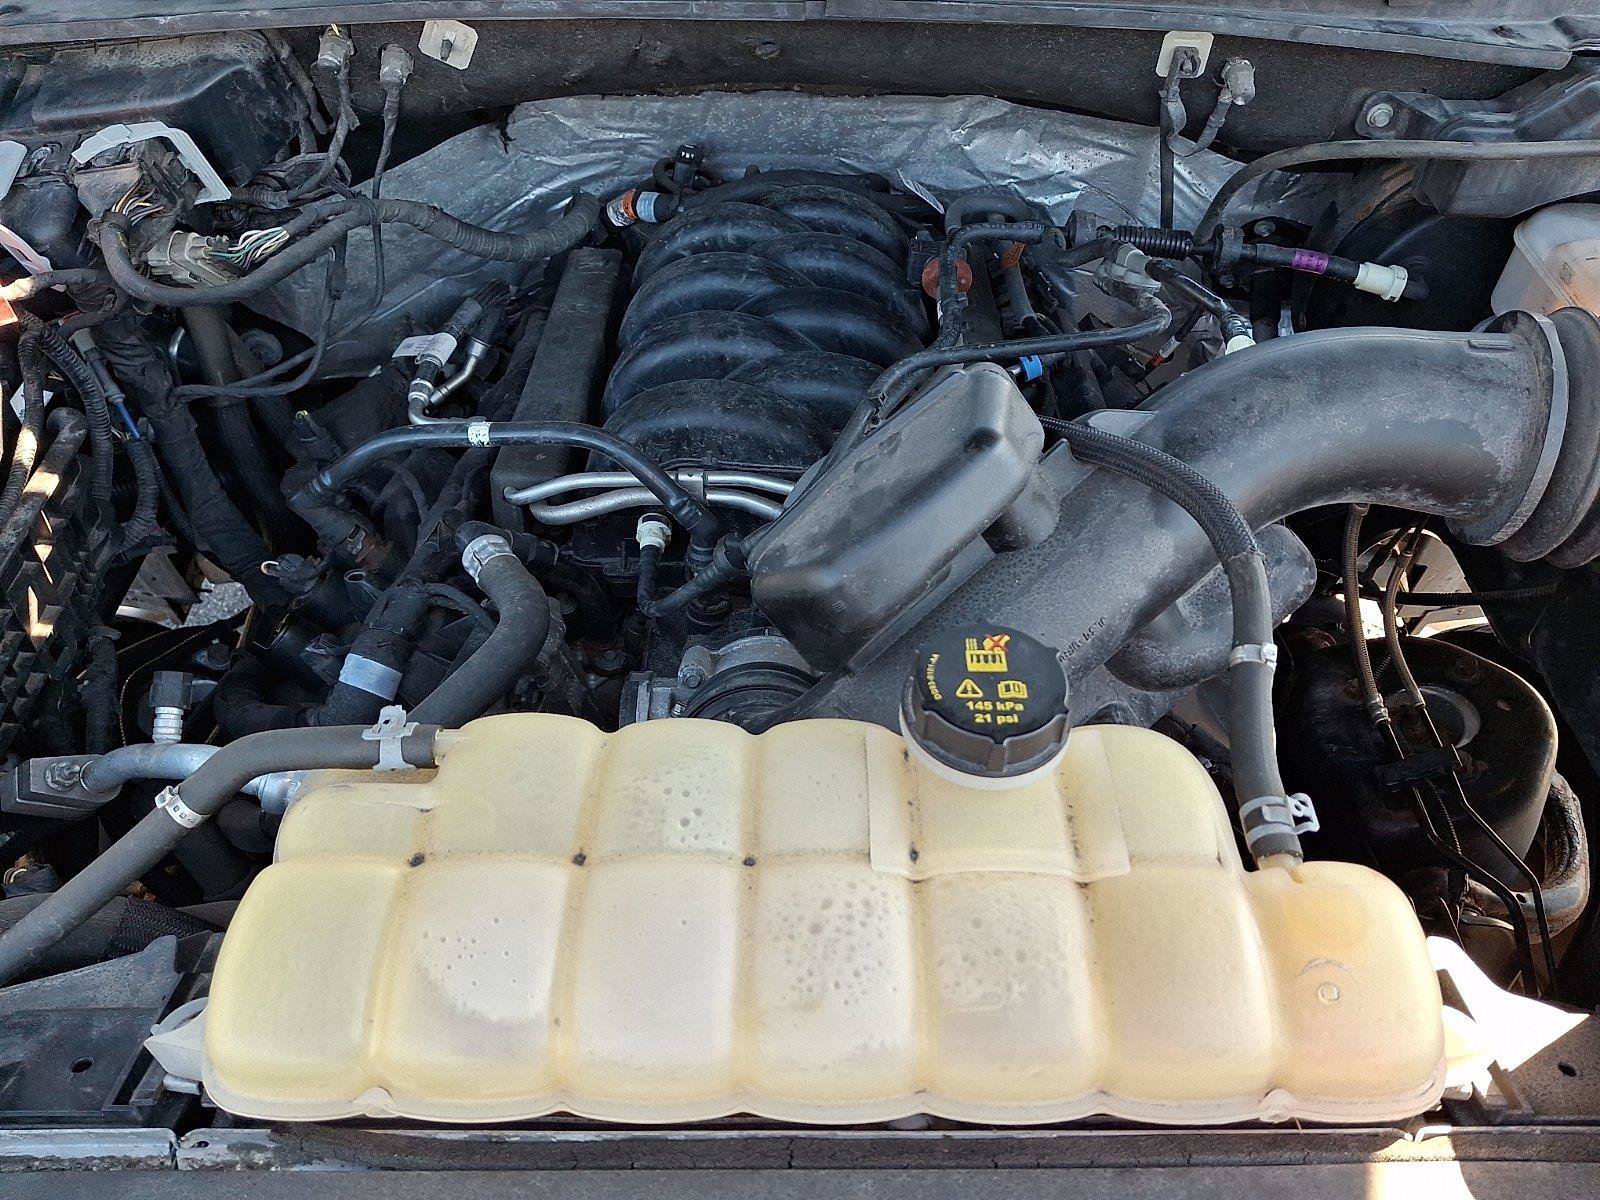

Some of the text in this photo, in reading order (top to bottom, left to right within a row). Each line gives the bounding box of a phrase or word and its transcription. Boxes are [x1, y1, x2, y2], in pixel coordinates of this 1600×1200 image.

[966, 700, 1024, 711] 145 kPa
[974, 713, 1019, 725] 21 psi
